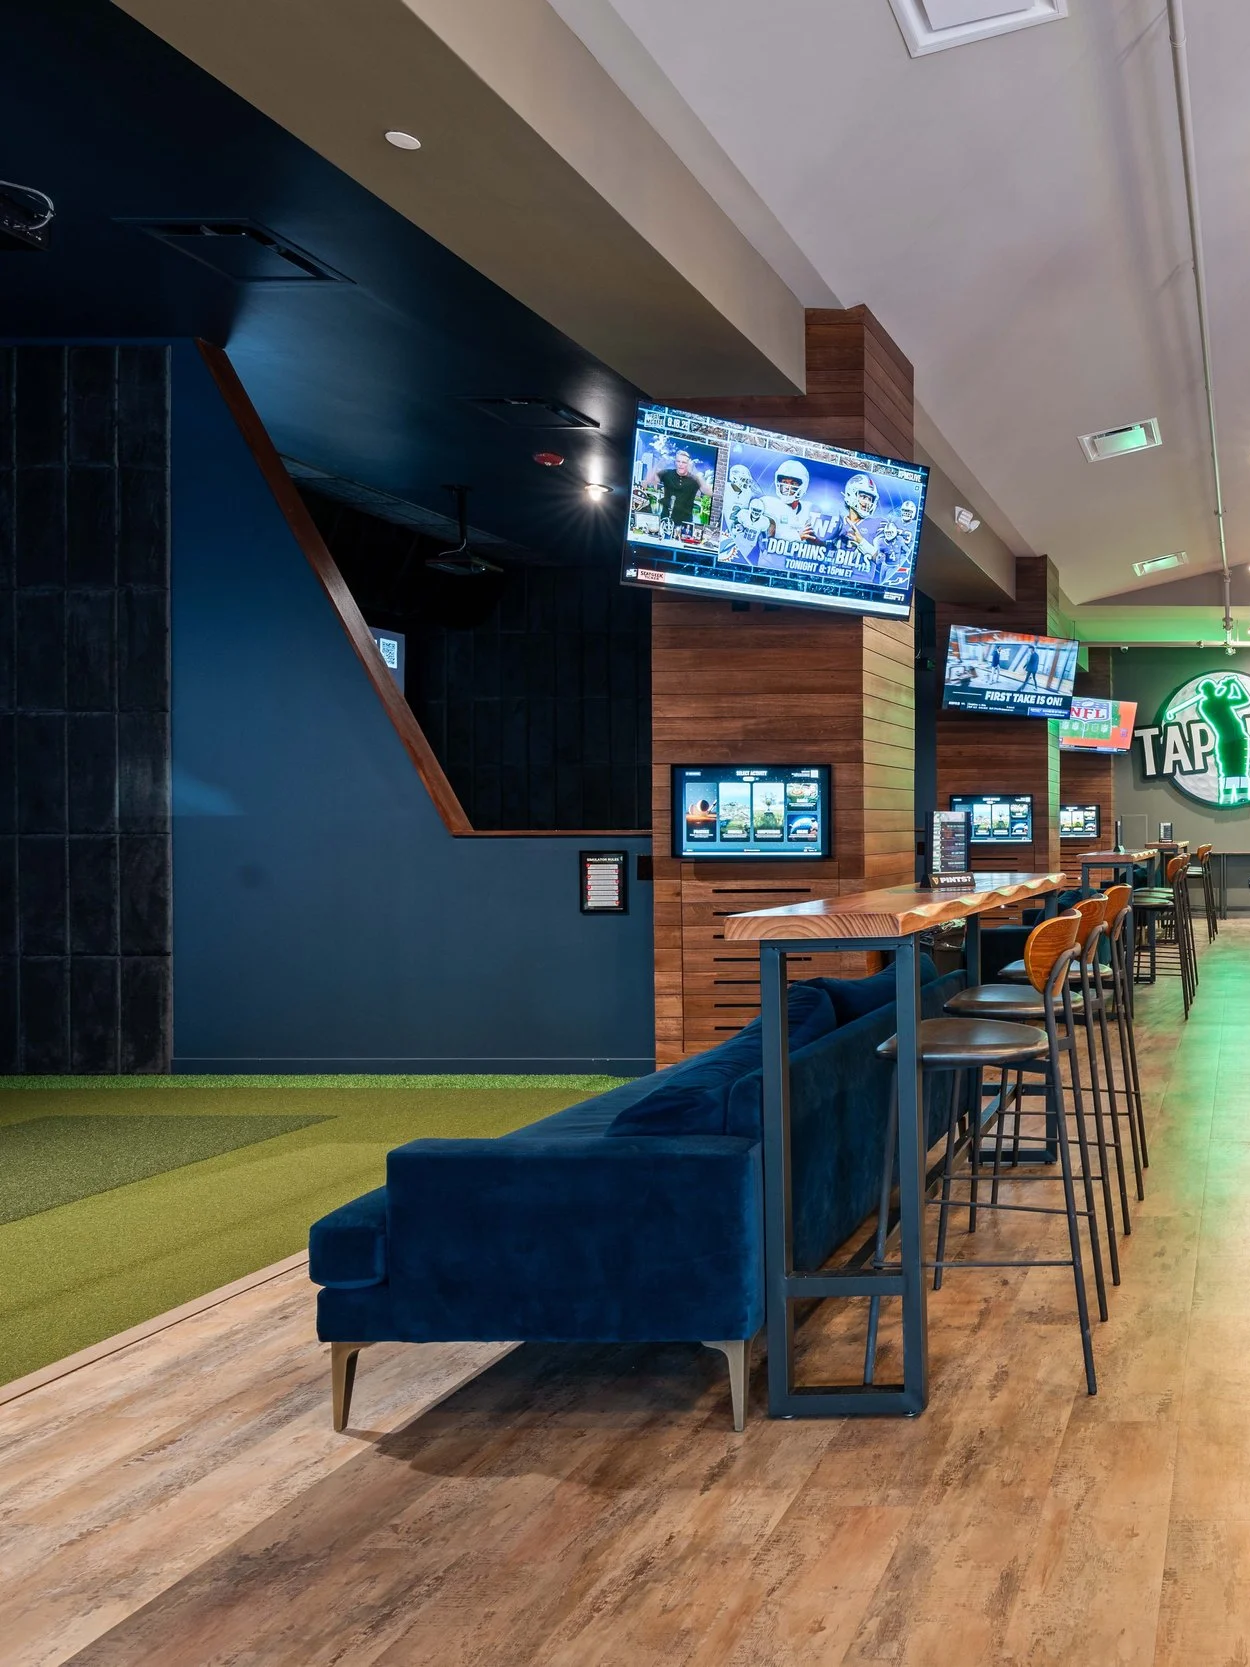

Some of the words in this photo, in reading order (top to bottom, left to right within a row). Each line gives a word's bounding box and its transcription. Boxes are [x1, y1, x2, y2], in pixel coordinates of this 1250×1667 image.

[809, 511, 840, 538] TNF
[767, 538, 825, 565] DOLPHINS
[835, 549, 872, 569] BILLS
[785, 558, 817, 573] TONIGHT
[819, 563, 845, 576] 8:15PM
[845, 569, 853, 577] ET
[883, 591, 905, 602] ESPN
[984, 691, 1012, 702] FIRST
[1012, 694, 1036, 704] TAKE
[1036, 696, 1045, 705] IS
[1046, 696, 1063, 706] ON!
[1070, 707, 1105, 719] NFL
[1135, 722, 1215, 776] TAP
[940, 876, 971, 884] PINTS?
